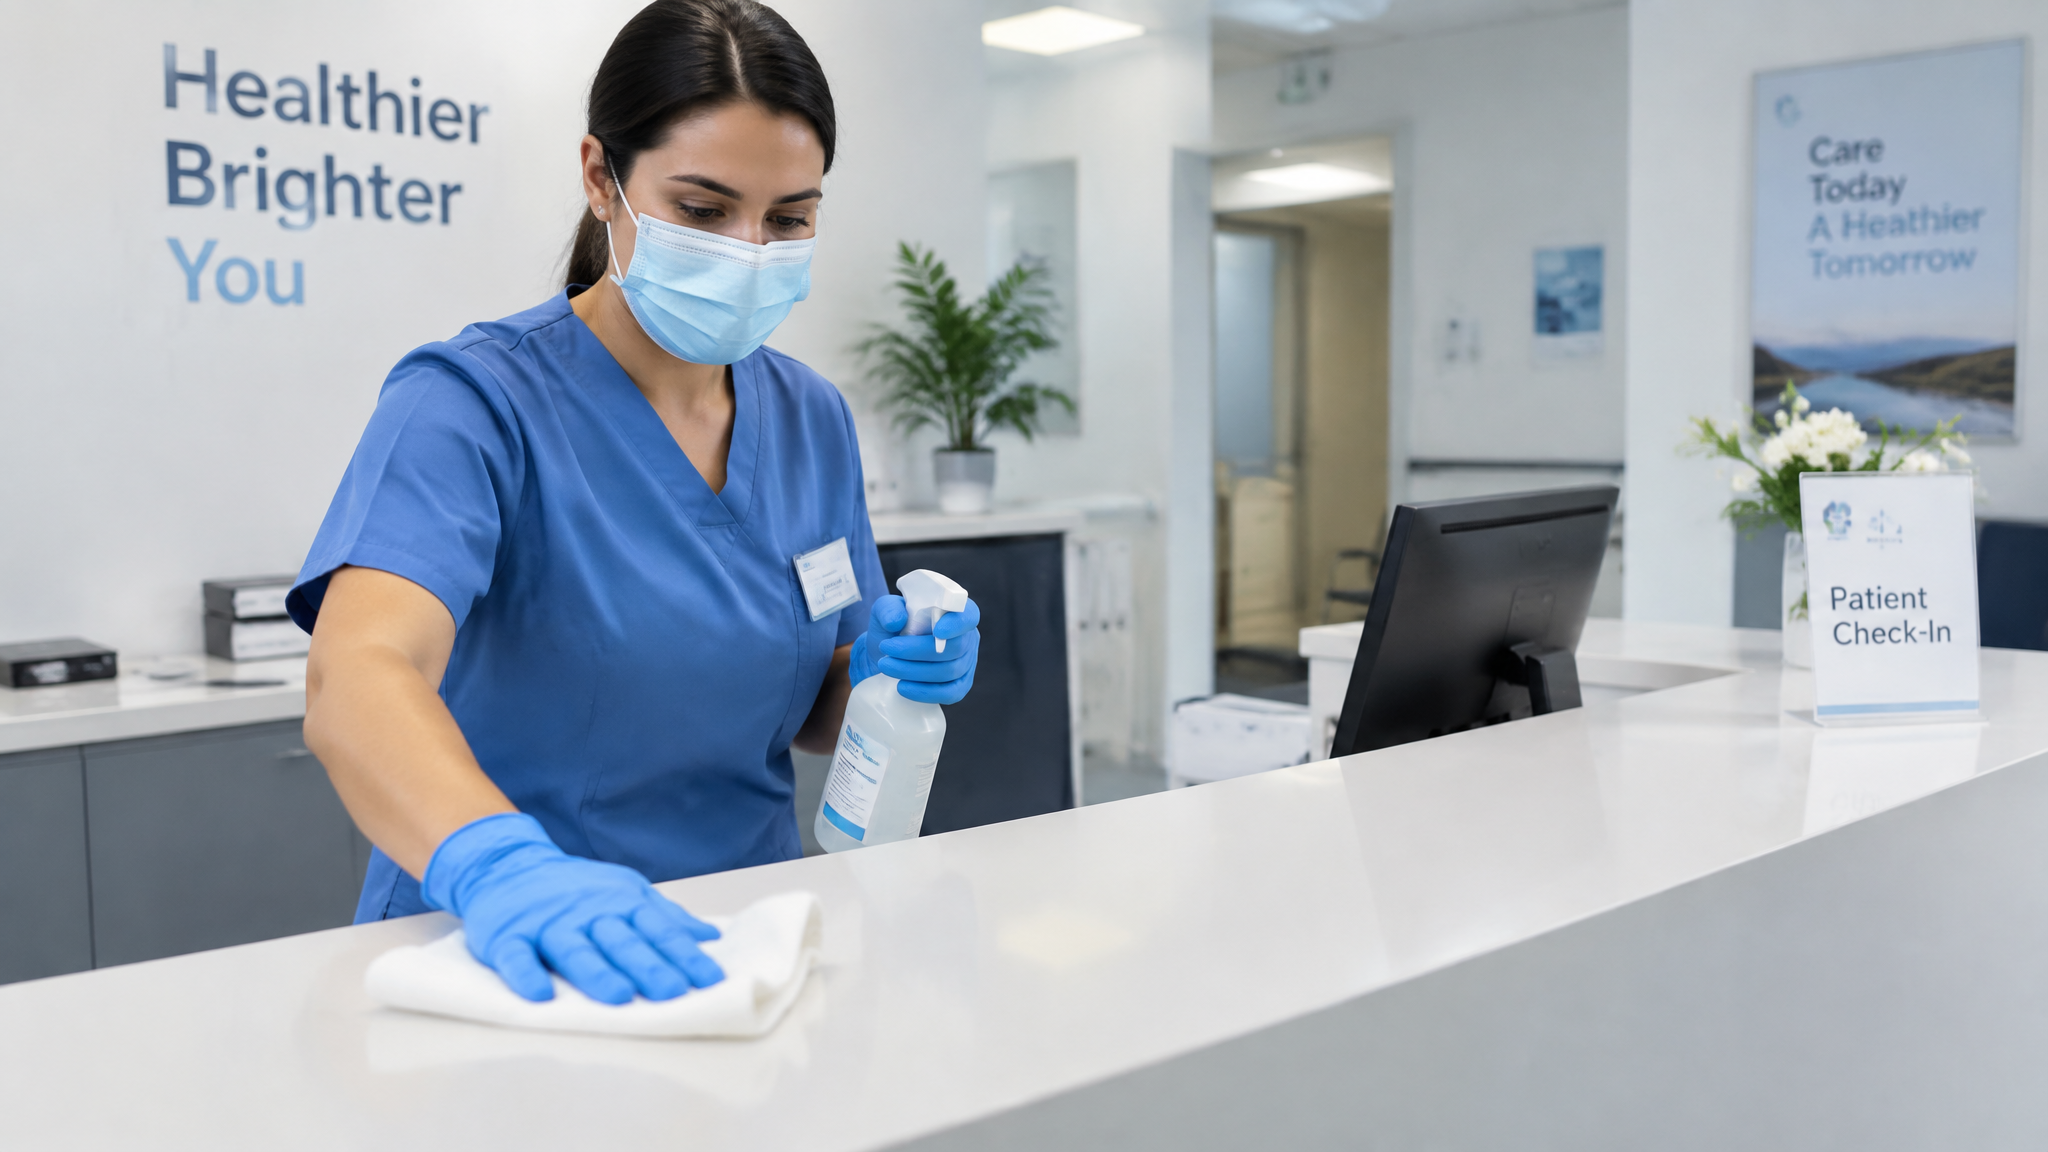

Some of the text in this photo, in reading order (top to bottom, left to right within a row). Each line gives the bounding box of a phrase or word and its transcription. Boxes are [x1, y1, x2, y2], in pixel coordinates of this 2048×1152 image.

[163, 43, 490, 144] Healthier
[1808, 135, 1885, 168] Care
[166, 139, 463, 231] Brighter
[1808, 171, 1908, 206] Today
[1807, 203, 1987, 243] A Heathier
[166, 237, 306, 306] You
[1808, 248, 1979, 280] Tomorrow
[1830, 585, 1928, 611] Patient
[1833, 619, 1952, 646] Check-In
